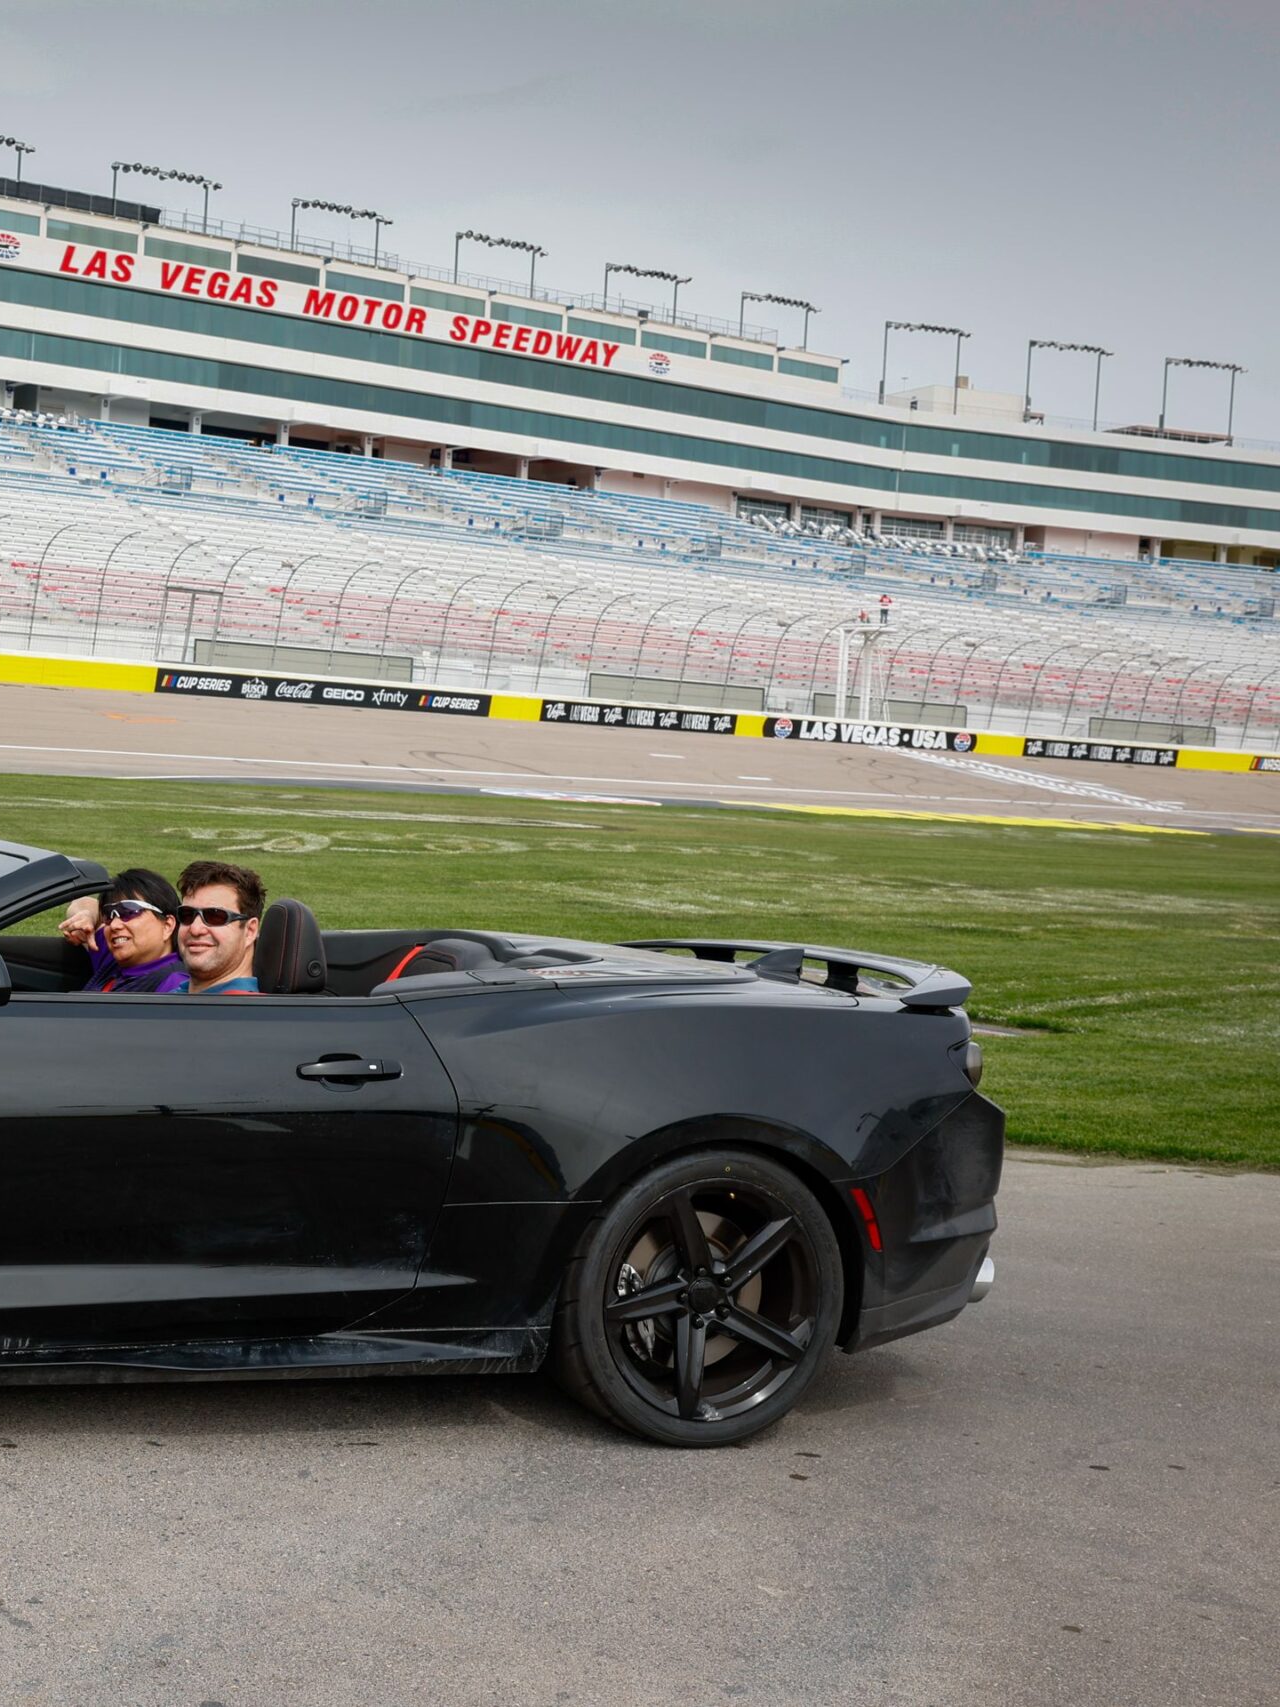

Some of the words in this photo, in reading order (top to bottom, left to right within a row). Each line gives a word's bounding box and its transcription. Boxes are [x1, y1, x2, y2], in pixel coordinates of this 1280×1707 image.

[60, 245, 135, 282] LAS
[161, 262, 278, 307] VEGAS
[304, 289, 427, 334] MOTOR
[450, 315, 618, 367] SPEEDWAY
[176, 676, 197, 689] CUP
[197, 678, 232, 691] SERIES
[241, 683, 268, 696] BUSCH
[322, 687, 365, 701] GEICO
[372, 689, 408, 707] xfinity
[431, 696, 449, 709] CUP
[449, 698, 480, 710] SERIES
[799, 720, 837, 742] LAS
[840, 724, 900, 746] VEGAS
[912, 730, 947, 749] USA
